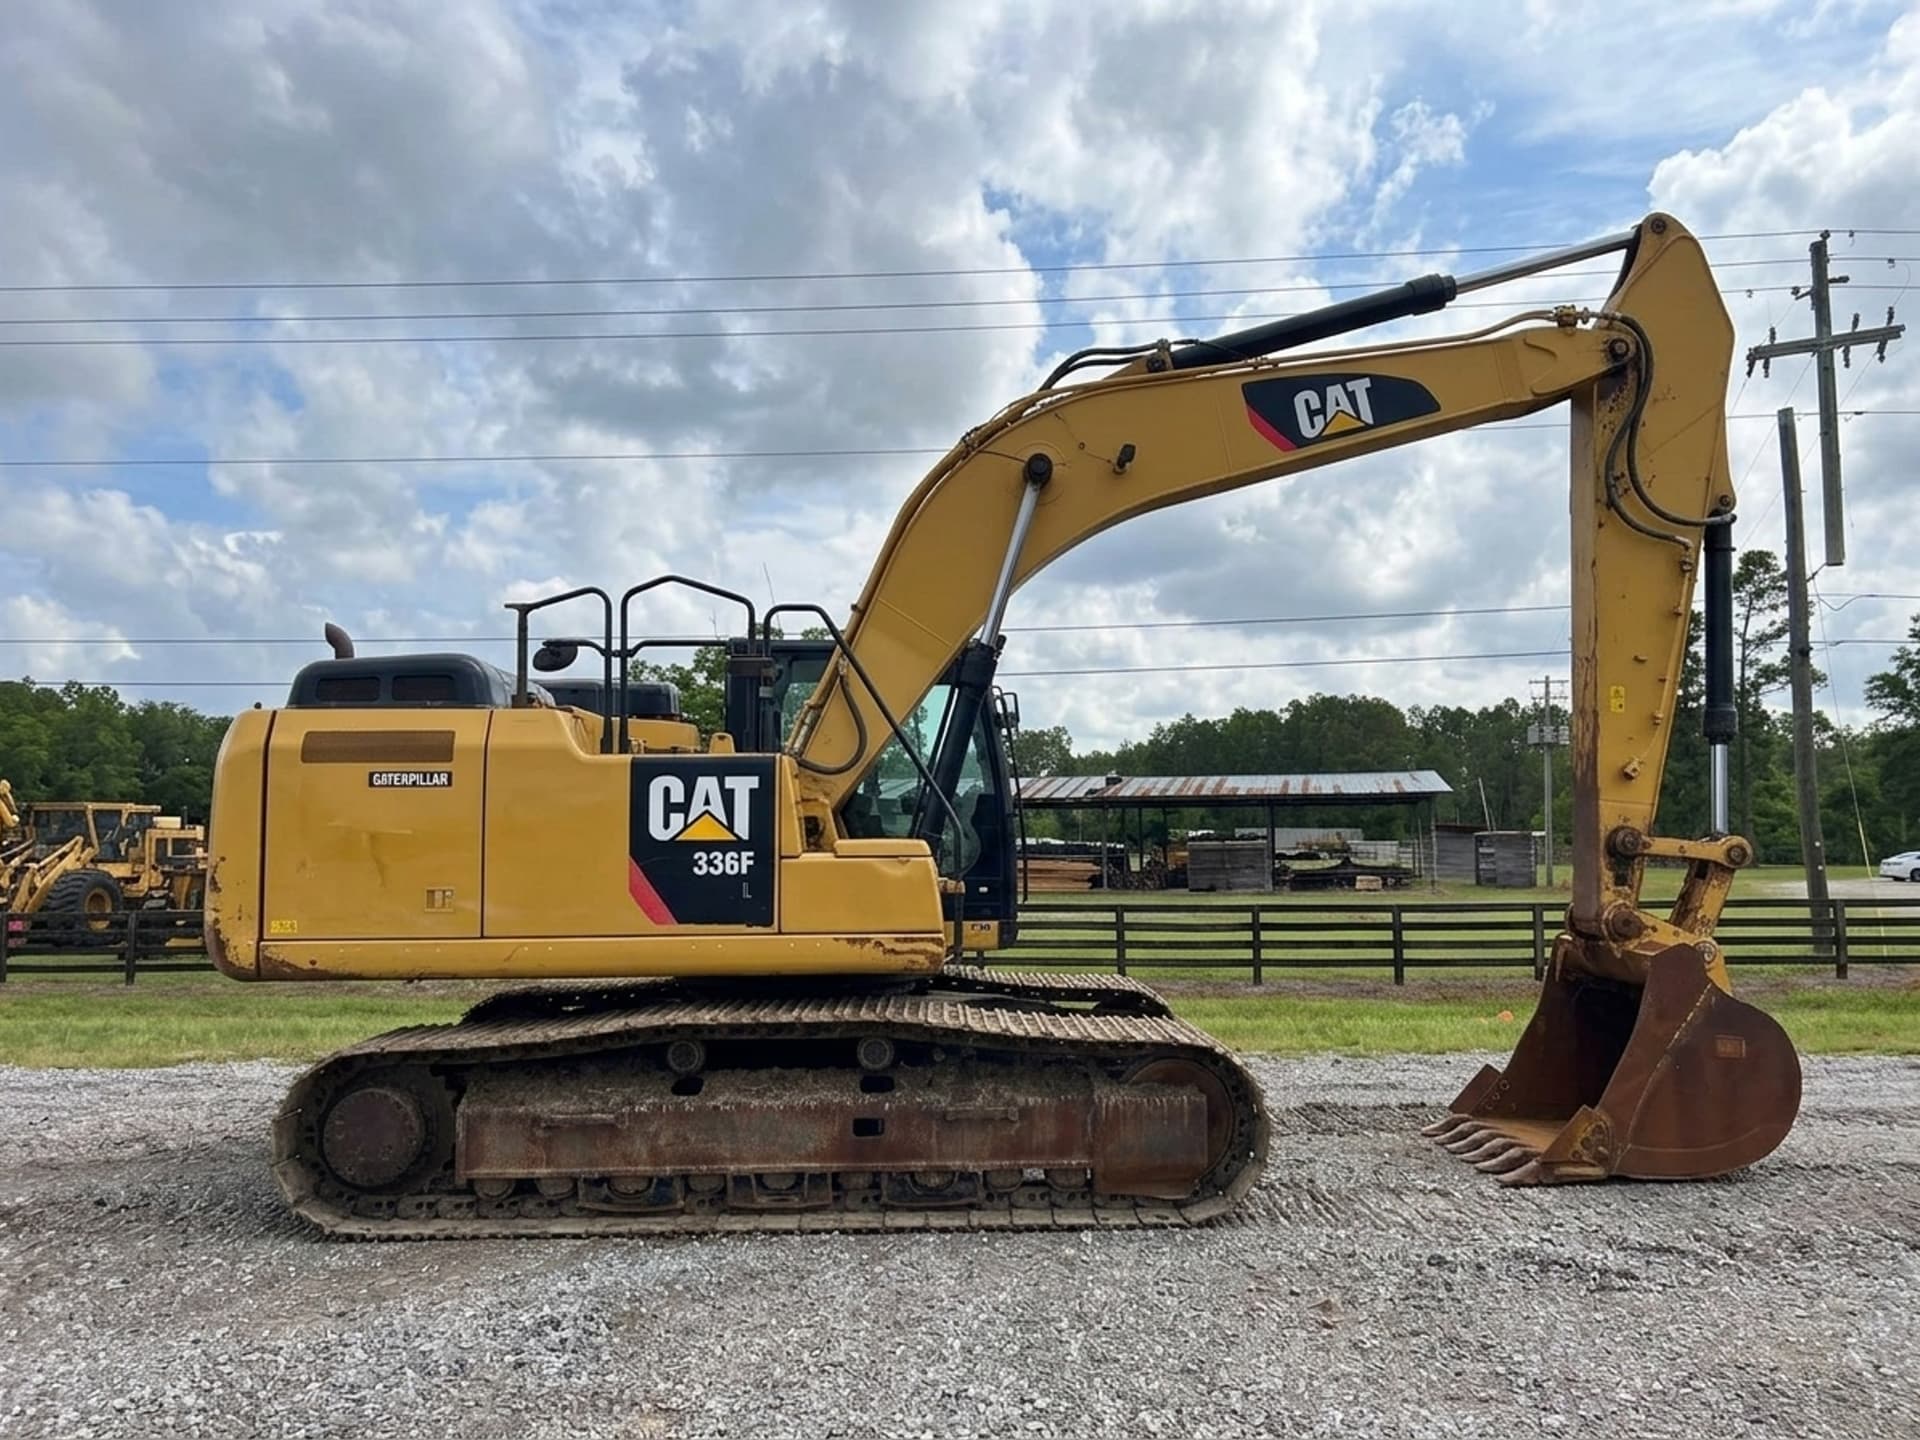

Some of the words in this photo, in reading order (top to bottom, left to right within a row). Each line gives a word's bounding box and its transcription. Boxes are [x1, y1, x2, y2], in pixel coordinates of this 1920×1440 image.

[1293, 377, 1374, 439] CAT
[648, 775, 760, 841] CAT
[692, 851, 755, 875] 336F
